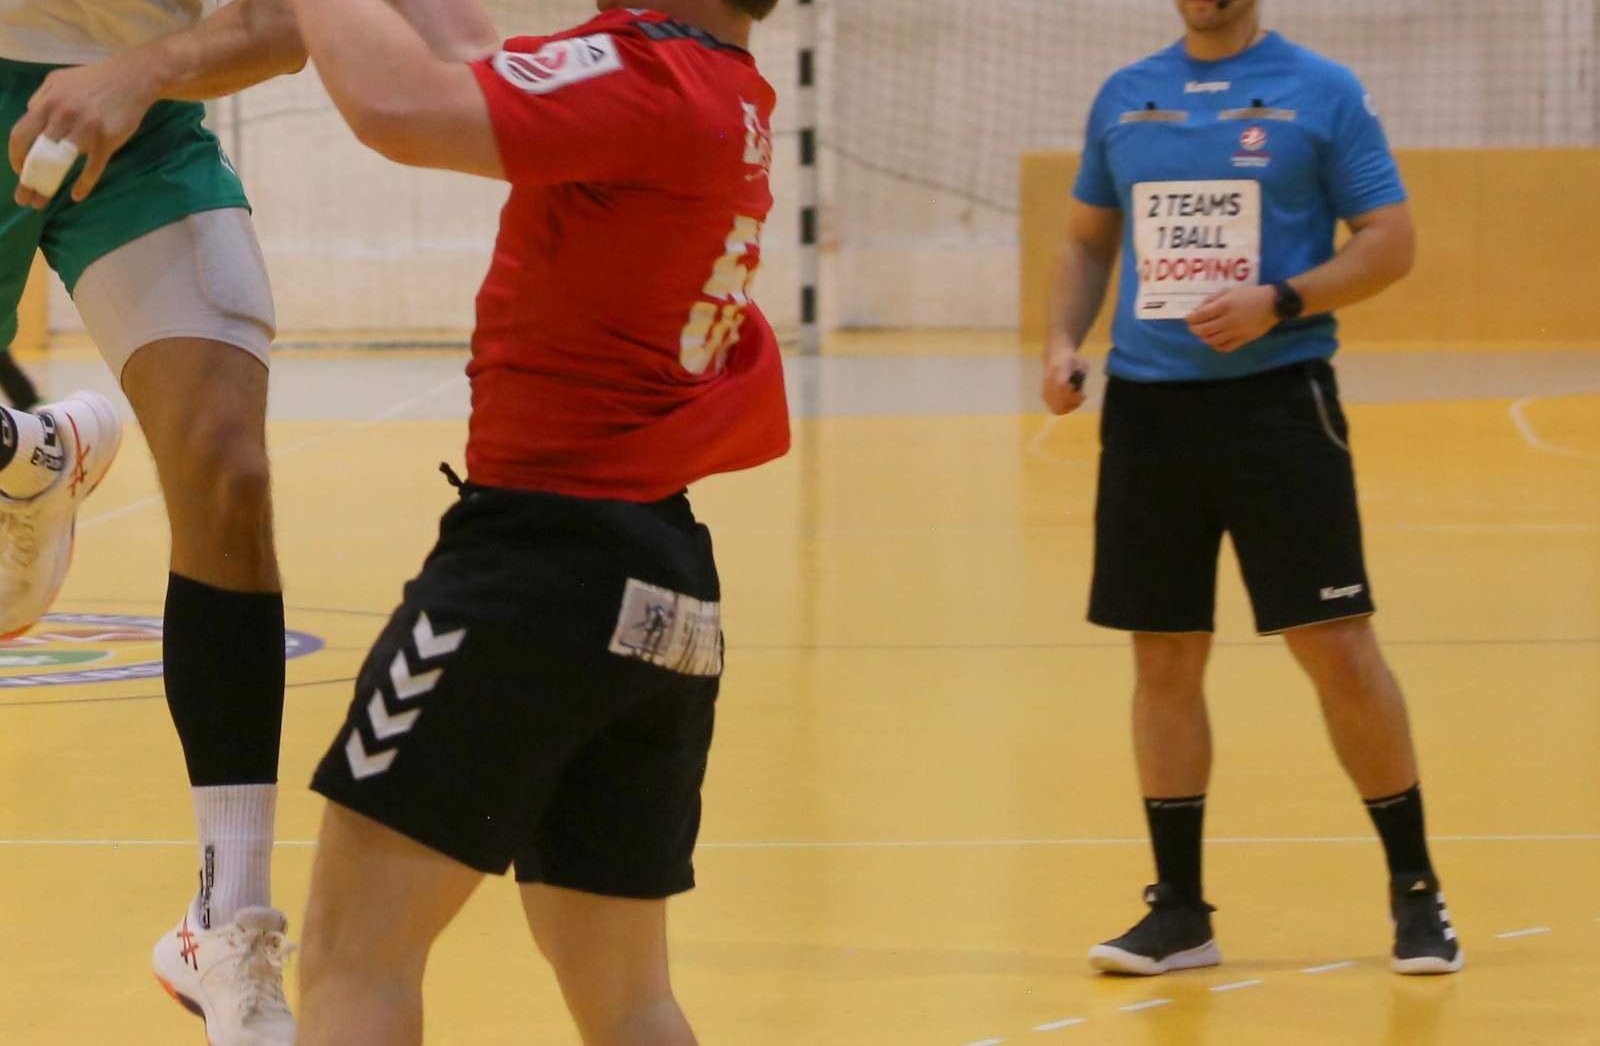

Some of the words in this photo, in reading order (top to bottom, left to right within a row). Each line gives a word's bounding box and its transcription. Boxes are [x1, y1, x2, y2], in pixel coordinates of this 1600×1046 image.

[1148, 194, 1160, 218] 2
[1166, 193, 1242, 217] TEAMS
[1157, 225, 1167, 249] 1
[1170, 225, 1227, 249] BALL
[1156, 257, 1250, 282] DOPING
